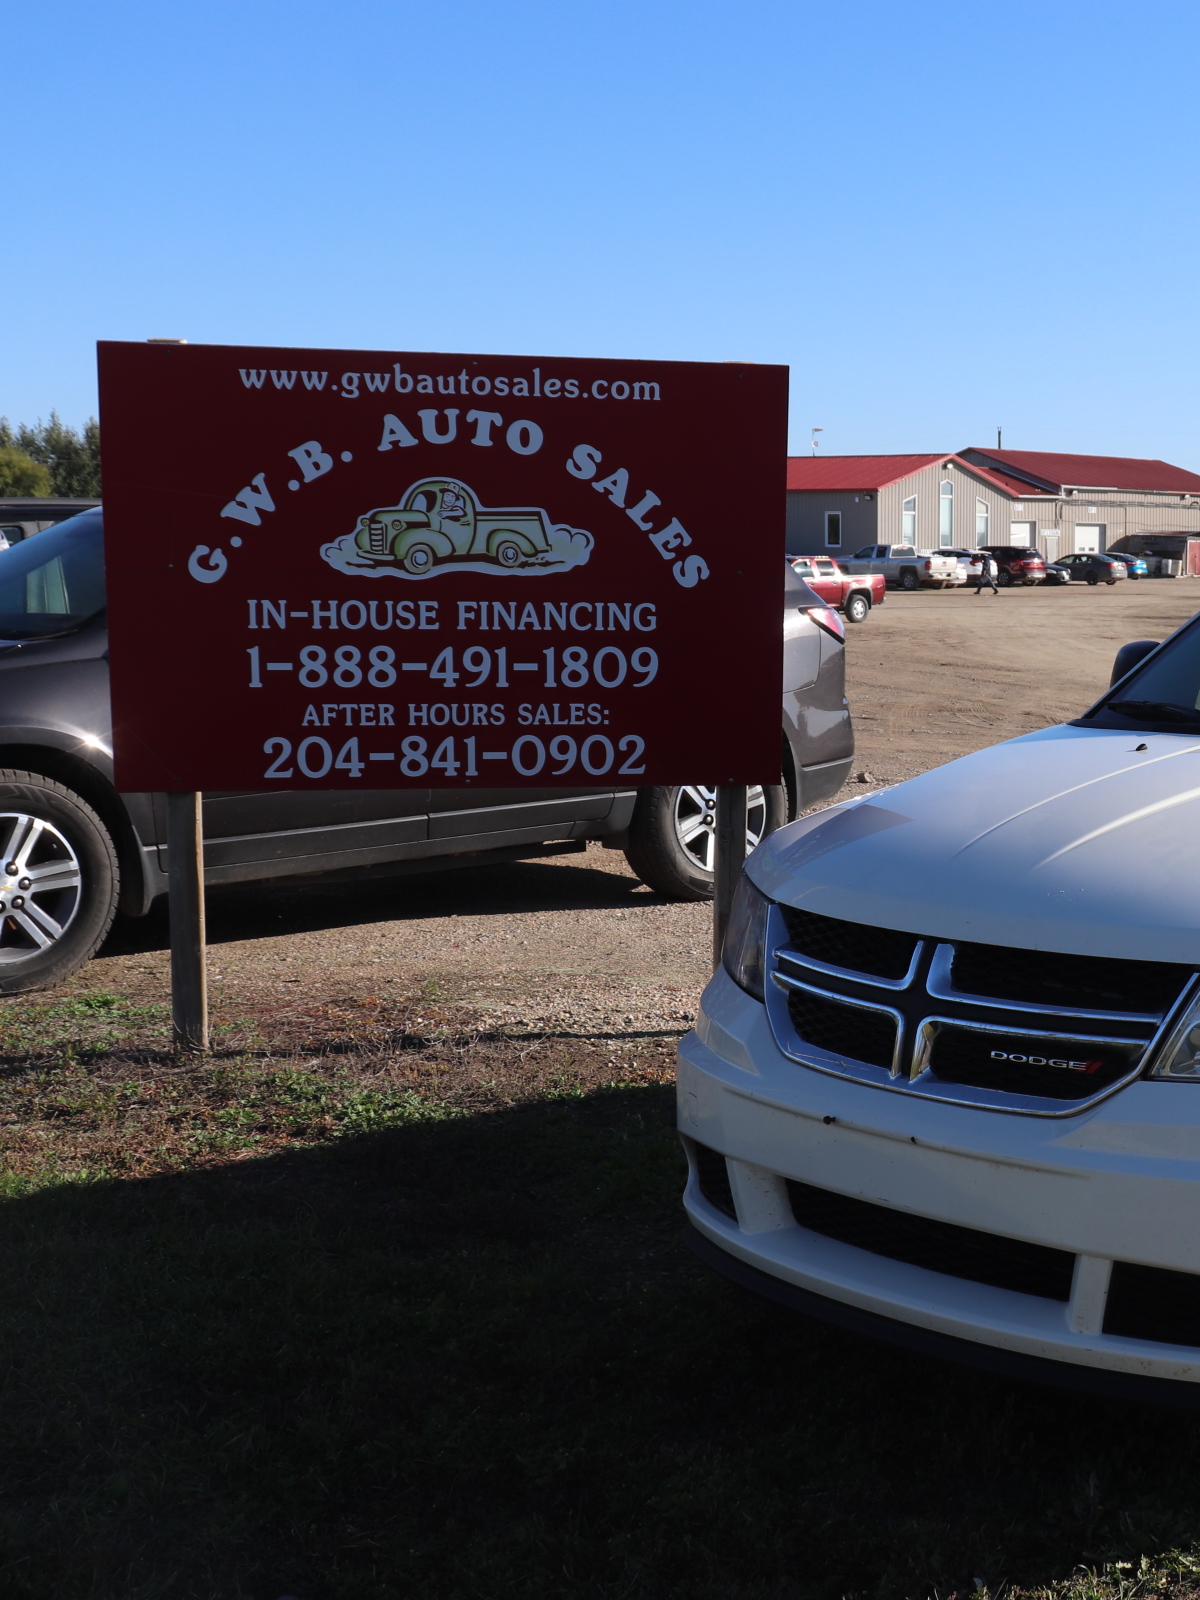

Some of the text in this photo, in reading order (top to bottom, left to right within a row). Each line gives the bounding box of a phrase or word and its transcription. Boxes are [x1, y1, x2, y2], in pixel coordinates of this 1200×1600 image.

[238, 364, 661, 401] www.gwbautosales.com
[188, 408, 710, 588] G.W.B. AUTO SALES
[247, 600, 658, 631] IN-HOUSE FINANCING
[247, 645, 660, 688] 1-888-491-1809
[301, 703, 610, 727] AFTER HOURS SALES:
[263, 735, 647, 779] 204-841-0902
[990, 1050, 1087, 1071] DODGE
